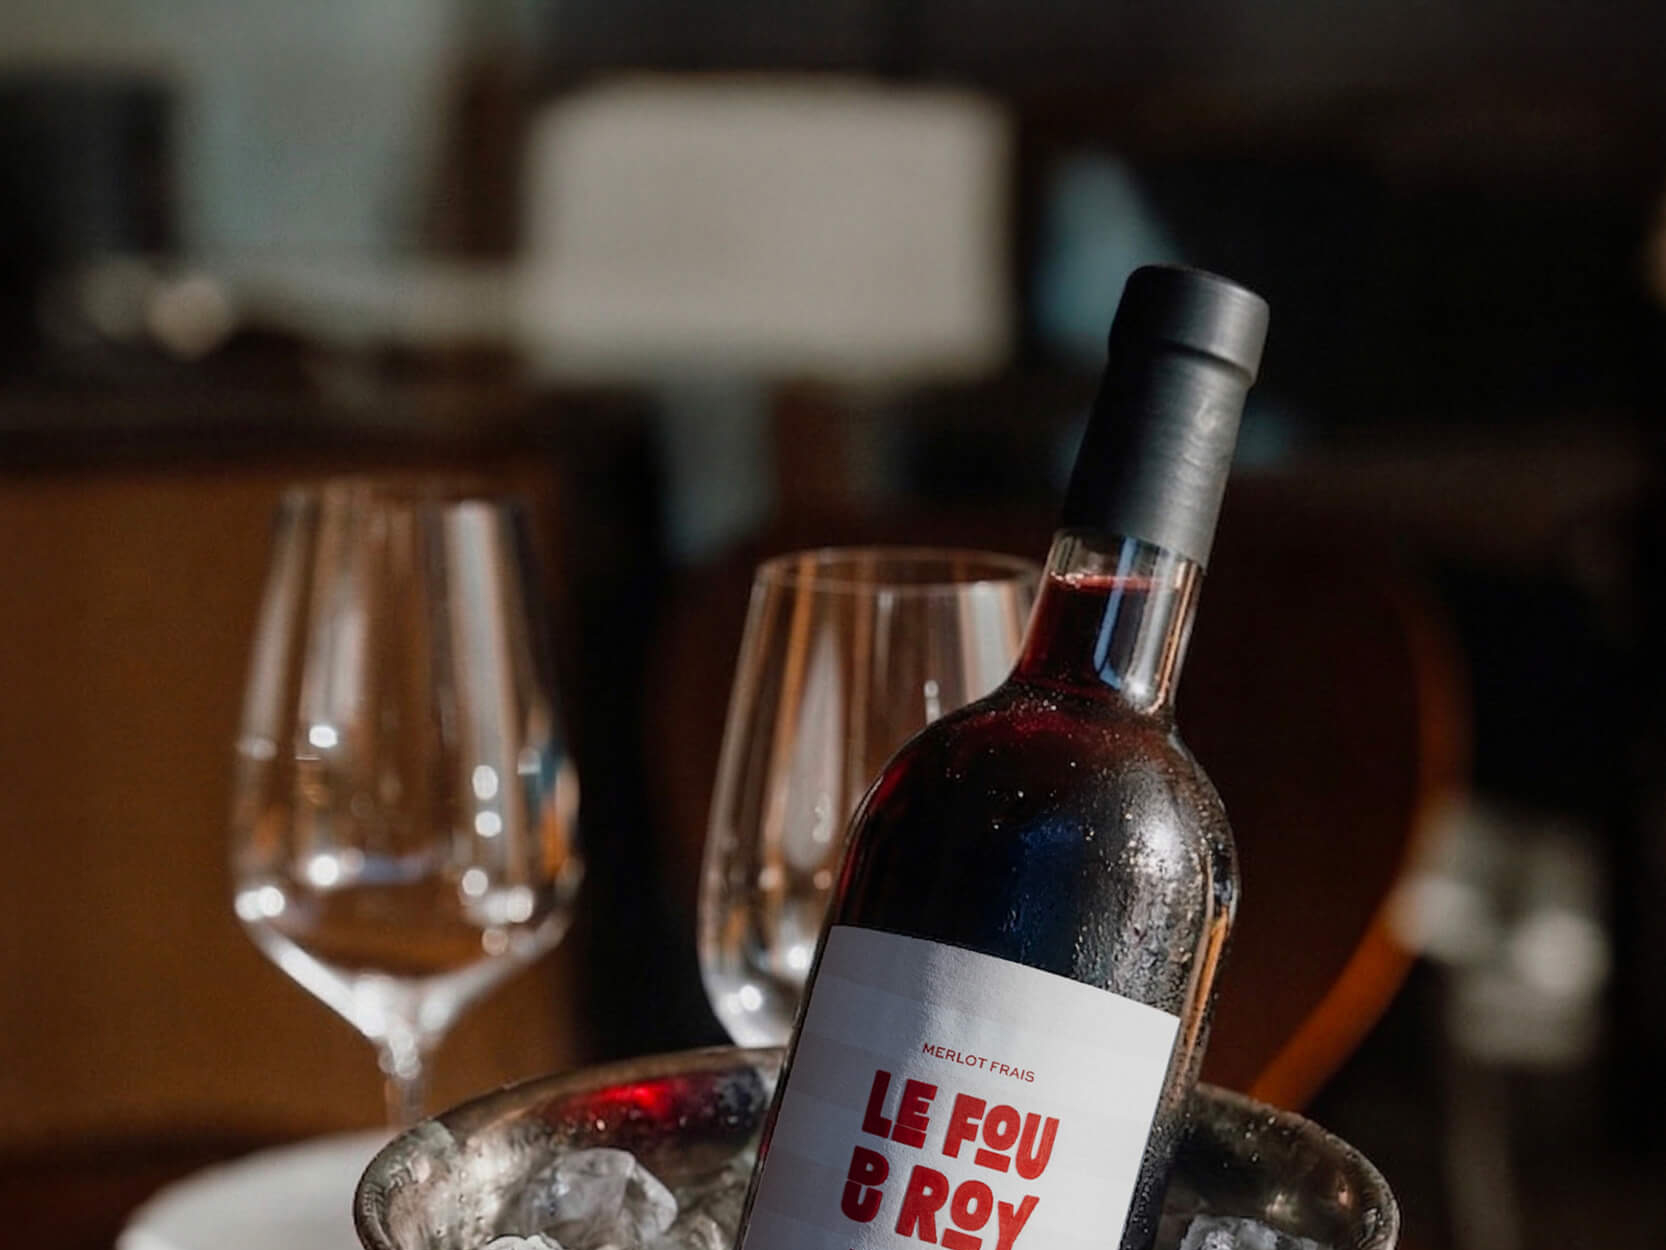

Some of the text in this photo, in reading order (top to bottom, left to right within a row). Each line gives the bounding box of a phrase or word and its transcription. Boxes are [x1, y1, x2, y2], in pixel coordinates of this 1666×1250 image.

[922, 1042, 1035, 1083] MERLOT FRAIS
[861, 1069, 1060, 1181] LE FOU
